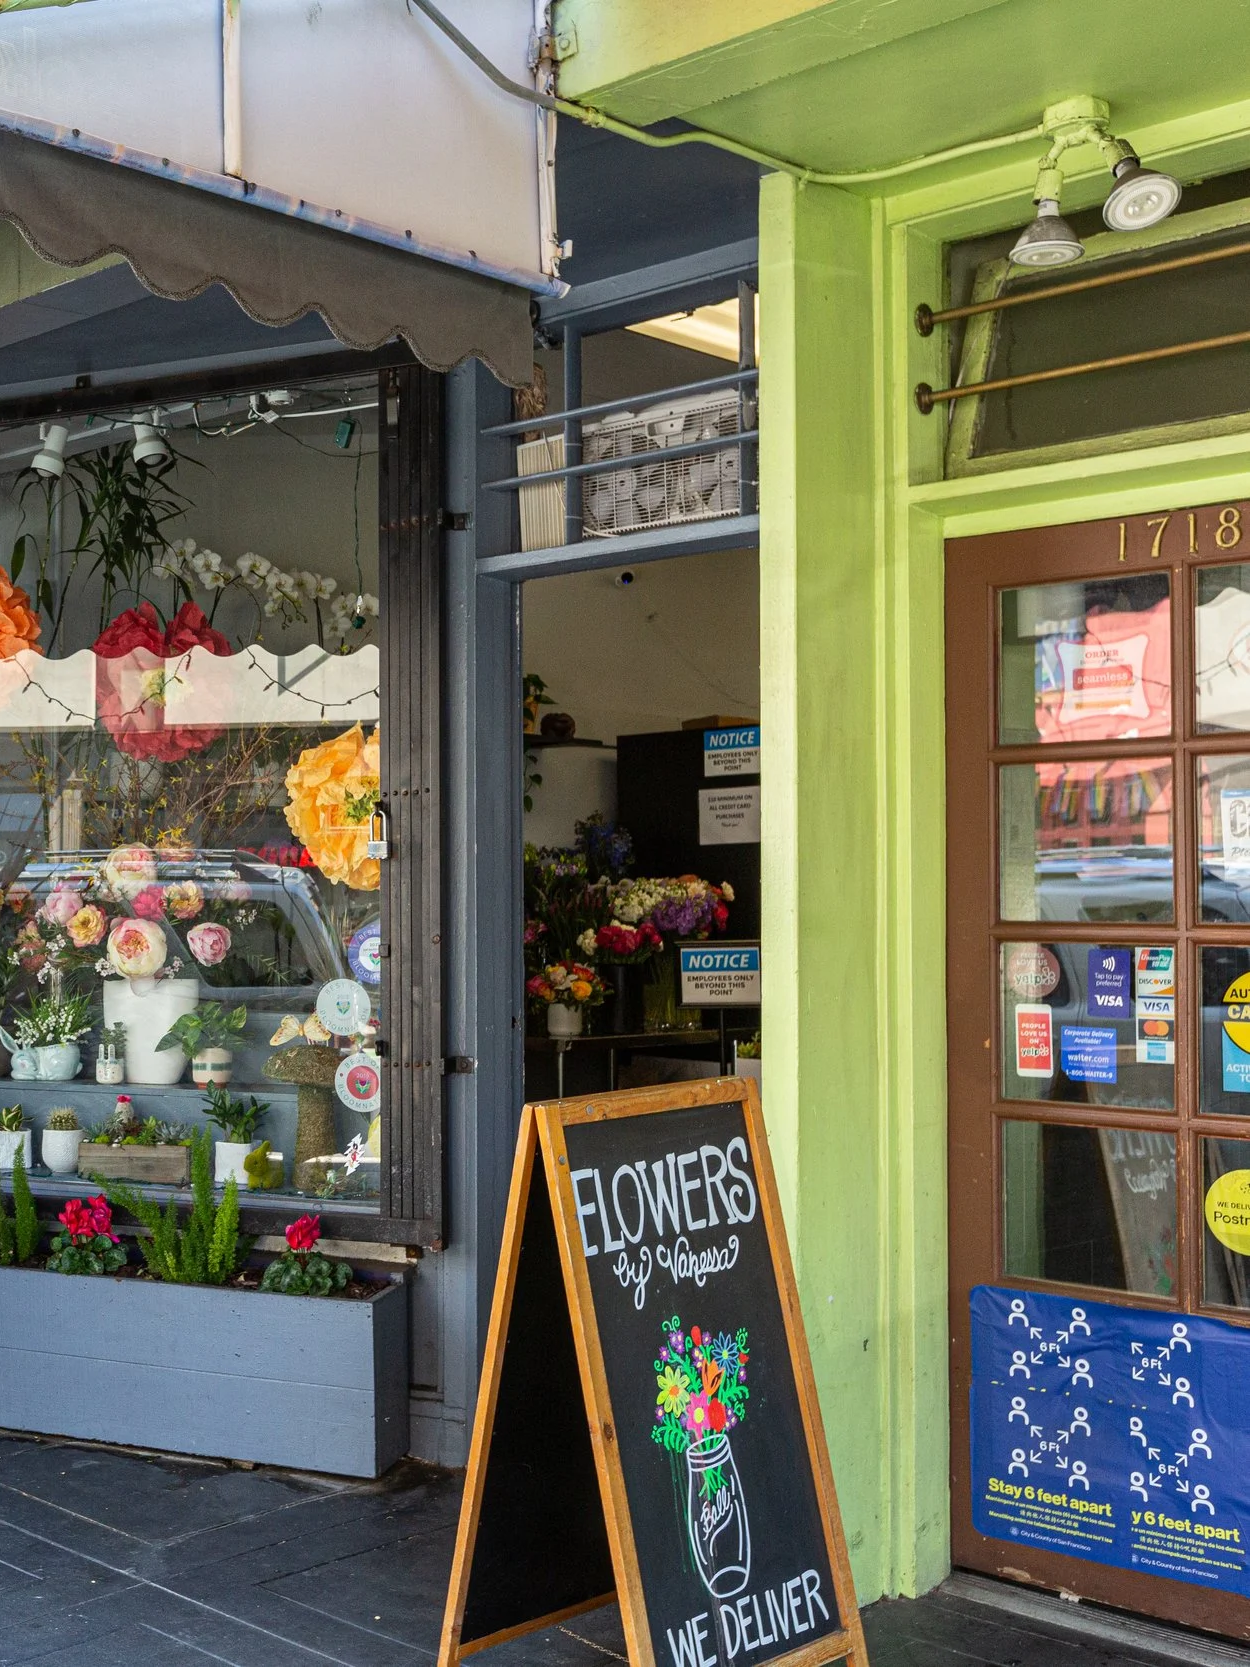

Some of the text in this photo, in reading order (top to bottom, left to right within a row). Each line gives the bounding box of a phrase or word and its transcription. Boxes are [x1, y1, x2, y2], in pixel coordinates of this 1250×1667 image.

[1118, 507, 1241, 562] 1718
[1077, 672, 1129, 685] seamless
[709, 731, 756, 748] NOTICE
[707, 751, 742, 760] EMPLOYEES
[713, 758, 737, 766] BEYOND
[688, 953, 750, 969] NOTICE
[1014, 972, 1042, 986] yelp
[1094, 973, 1105, 981] Tap
[1112, 974, 1124, 983] pay
[1095, 980, 1122, 988] preferred
[1094, 994, 1124, 1007] VISA
[1143, 1001, 1170, 1011] VISA
[1091, 1030, 1114, 1040] Delivery
[1020, 1046, 1041, 1057] yelp
[1067, 1053, 1109, 1065] waiter.com
[612, 1234, 740, 1310] by Vanessa
[1039, 1342, 1061, 1354] 6 Ft
[1141, 1357, 1162, 1371] 6 Ft
[1039, 1441, 1060, 1453] 6 Ft
[1158, 1463, 1179, 1477] 6 Ft
[988, 1477, 1112, 1517] Stay 6 feet apart
[700, 1484, 734, 1541] Ball
[1143, 1511, 1156, 1525] 6
[1158, 1513, 1192, 1533] feet
[1193, 1523, 1241, 1543] apart
[1020, 1530, 1030, 1538] City
[1035, 1533, 1053, 1542] County
[1067, 1540, 1092, 1551] Francisco
[1140, 1557, 1151, 1565] City
[1155, 1561, 1175, 1571] County
[1192, 1568, 1219, 1579] Francisco
[666, 1569, 830, 1667] WE DELIVER
